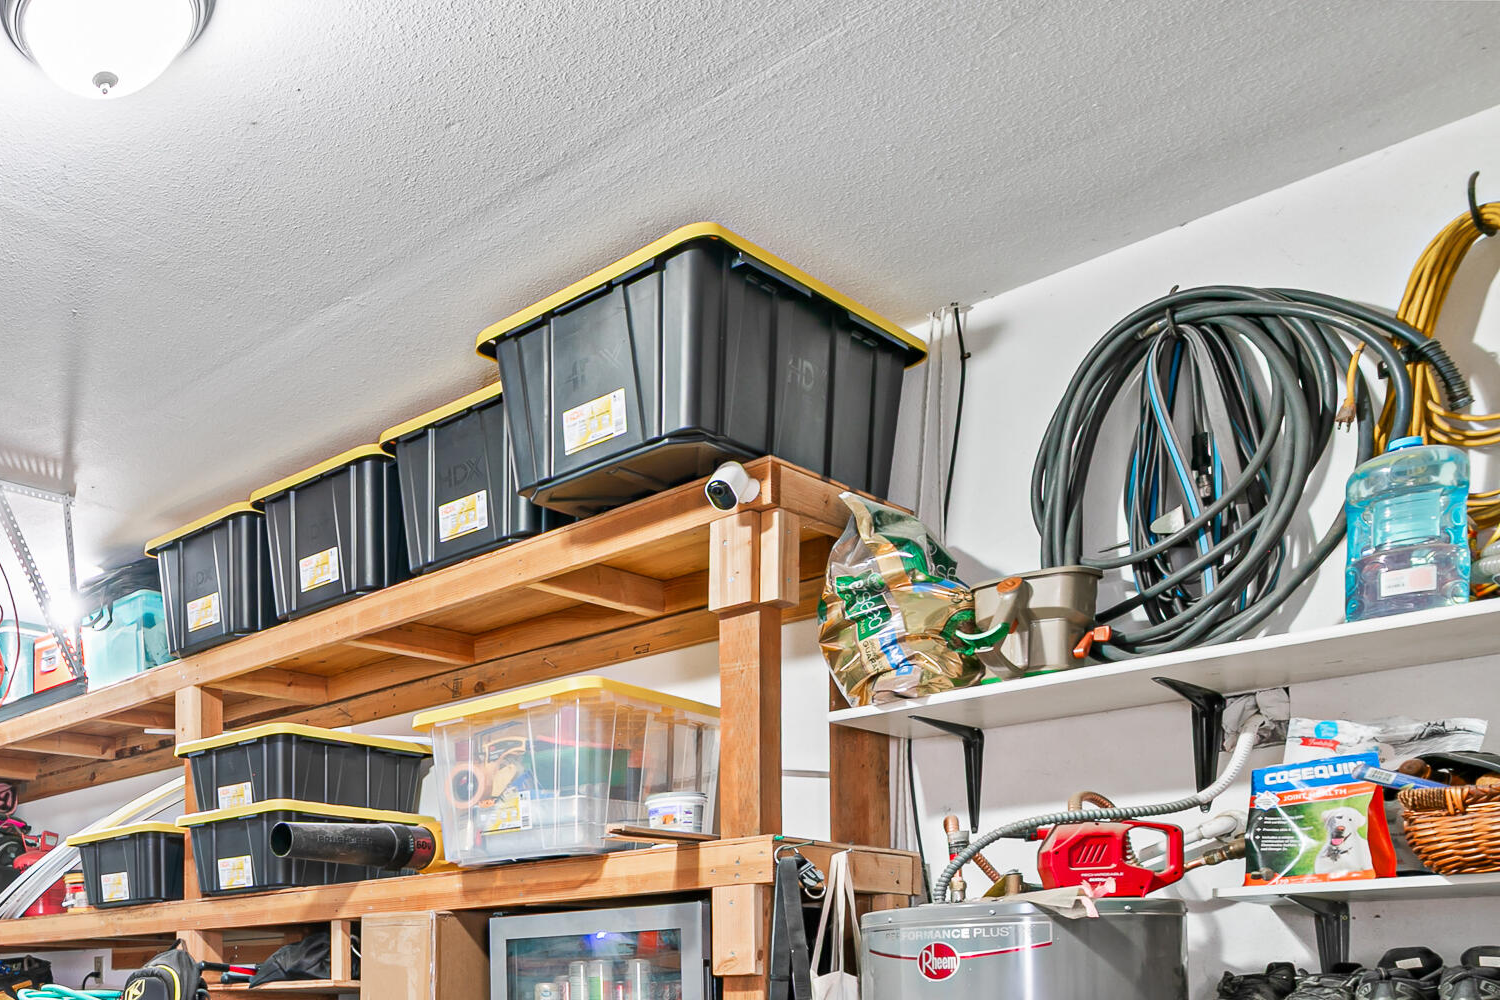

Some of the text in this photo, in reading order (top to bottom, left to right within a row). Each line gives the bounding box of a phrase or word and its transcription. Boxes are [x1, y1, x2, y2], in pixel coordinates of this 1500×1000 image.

[1264, 761, 1365, 785] COSEQUIN
[973, 927, 1009, 938] PLUS
[922, 943, 957, 975] Rheem
